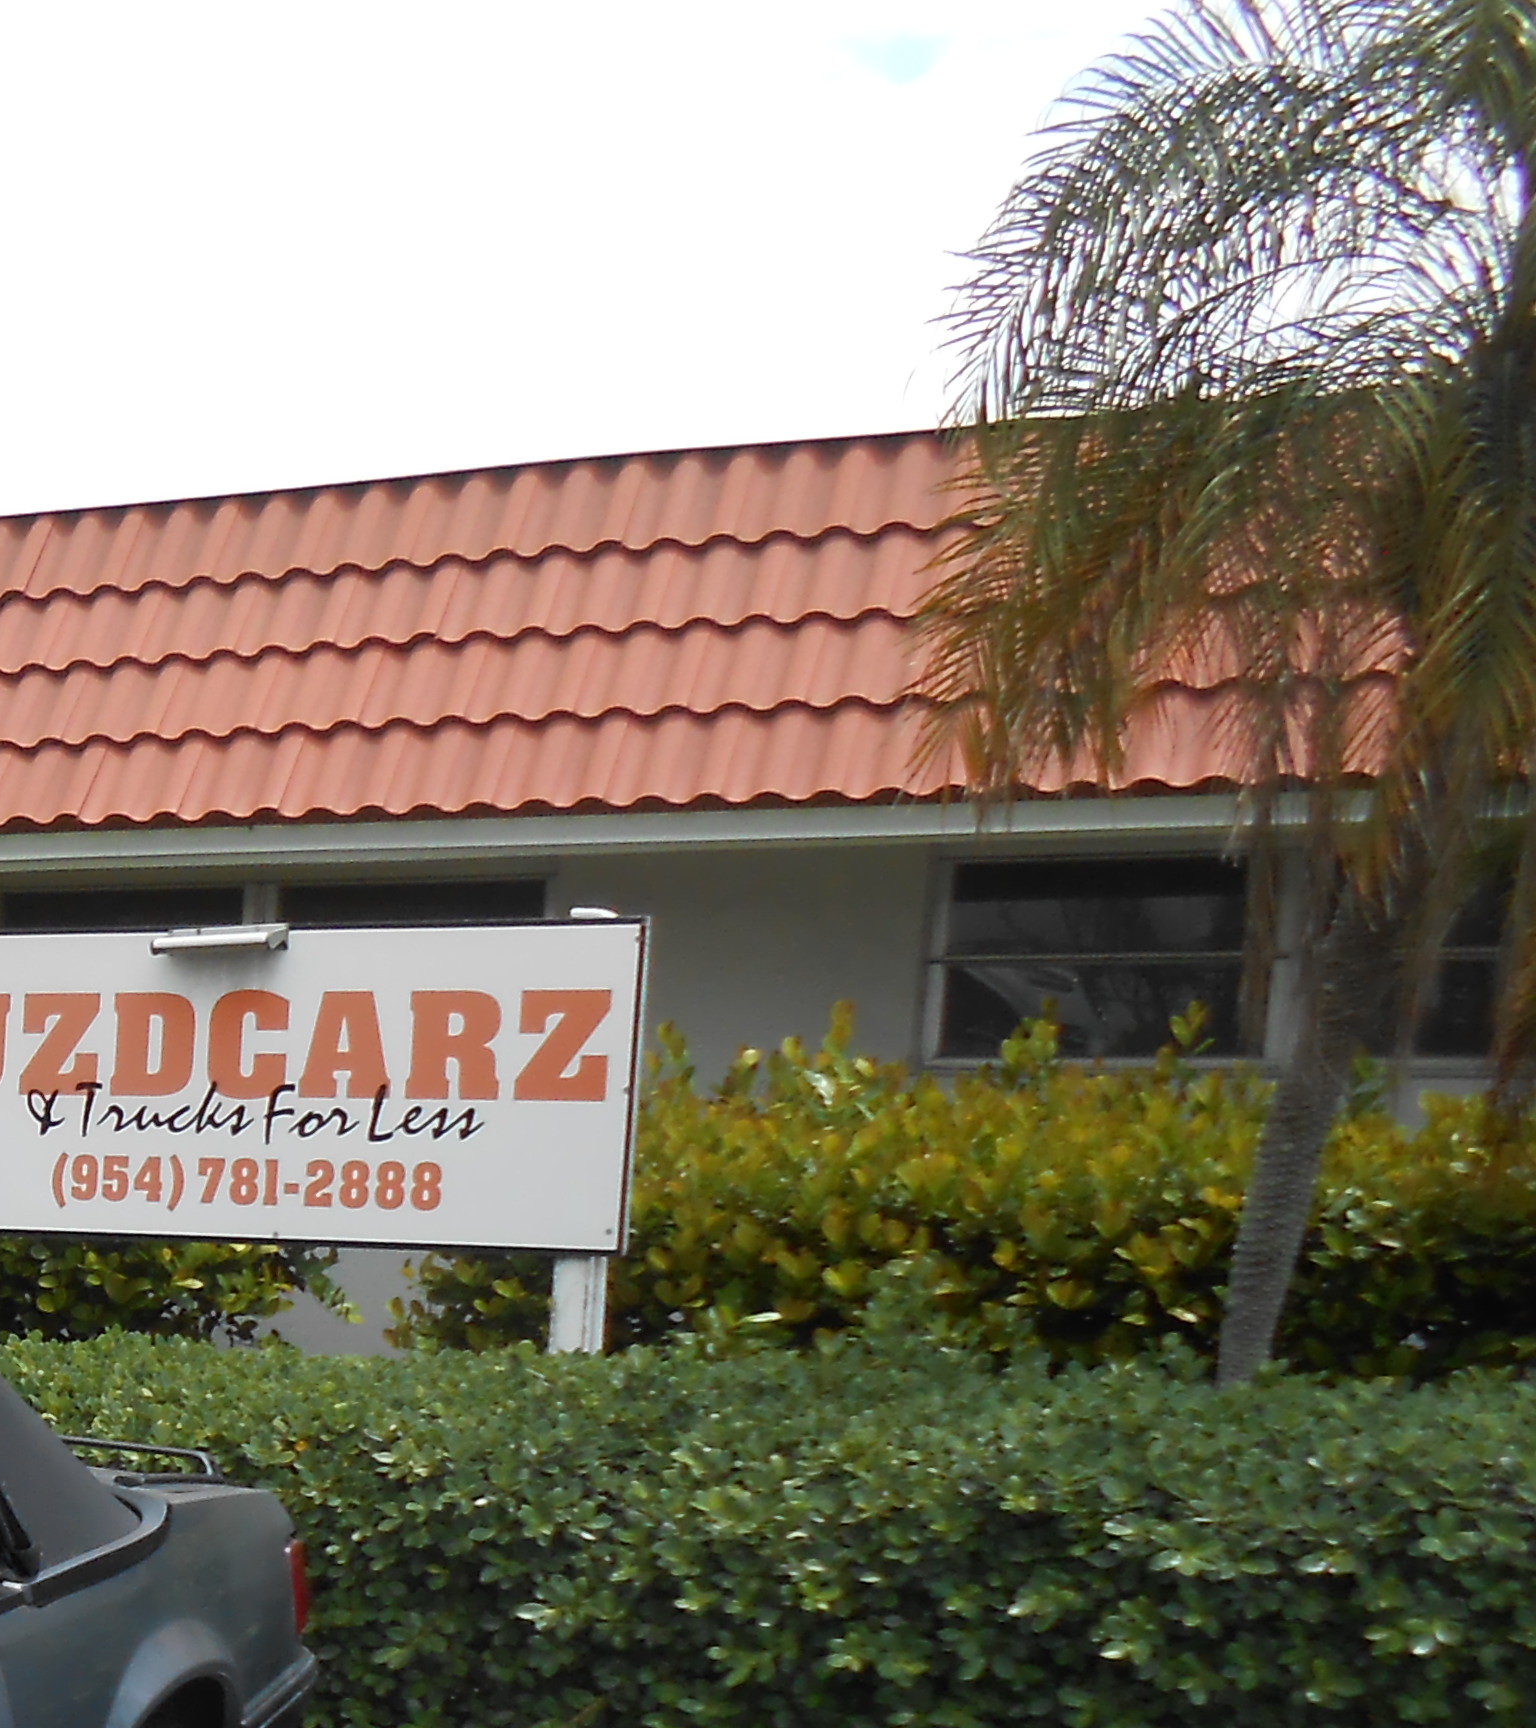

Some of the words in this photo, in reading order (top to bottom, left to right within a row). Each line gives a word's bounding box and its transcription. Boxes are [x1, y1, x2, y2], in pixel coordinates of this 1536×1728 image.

[27, 1088, 65, 1136] &
[68, 1082, 255, 1137] Trucks
[263, 1083, 360, 1145] For
[366, 1083, 486, 1143] Less
[51, 1152, 186, 1212] (954)
[197, 1157, 444, 1212] 781-2888
